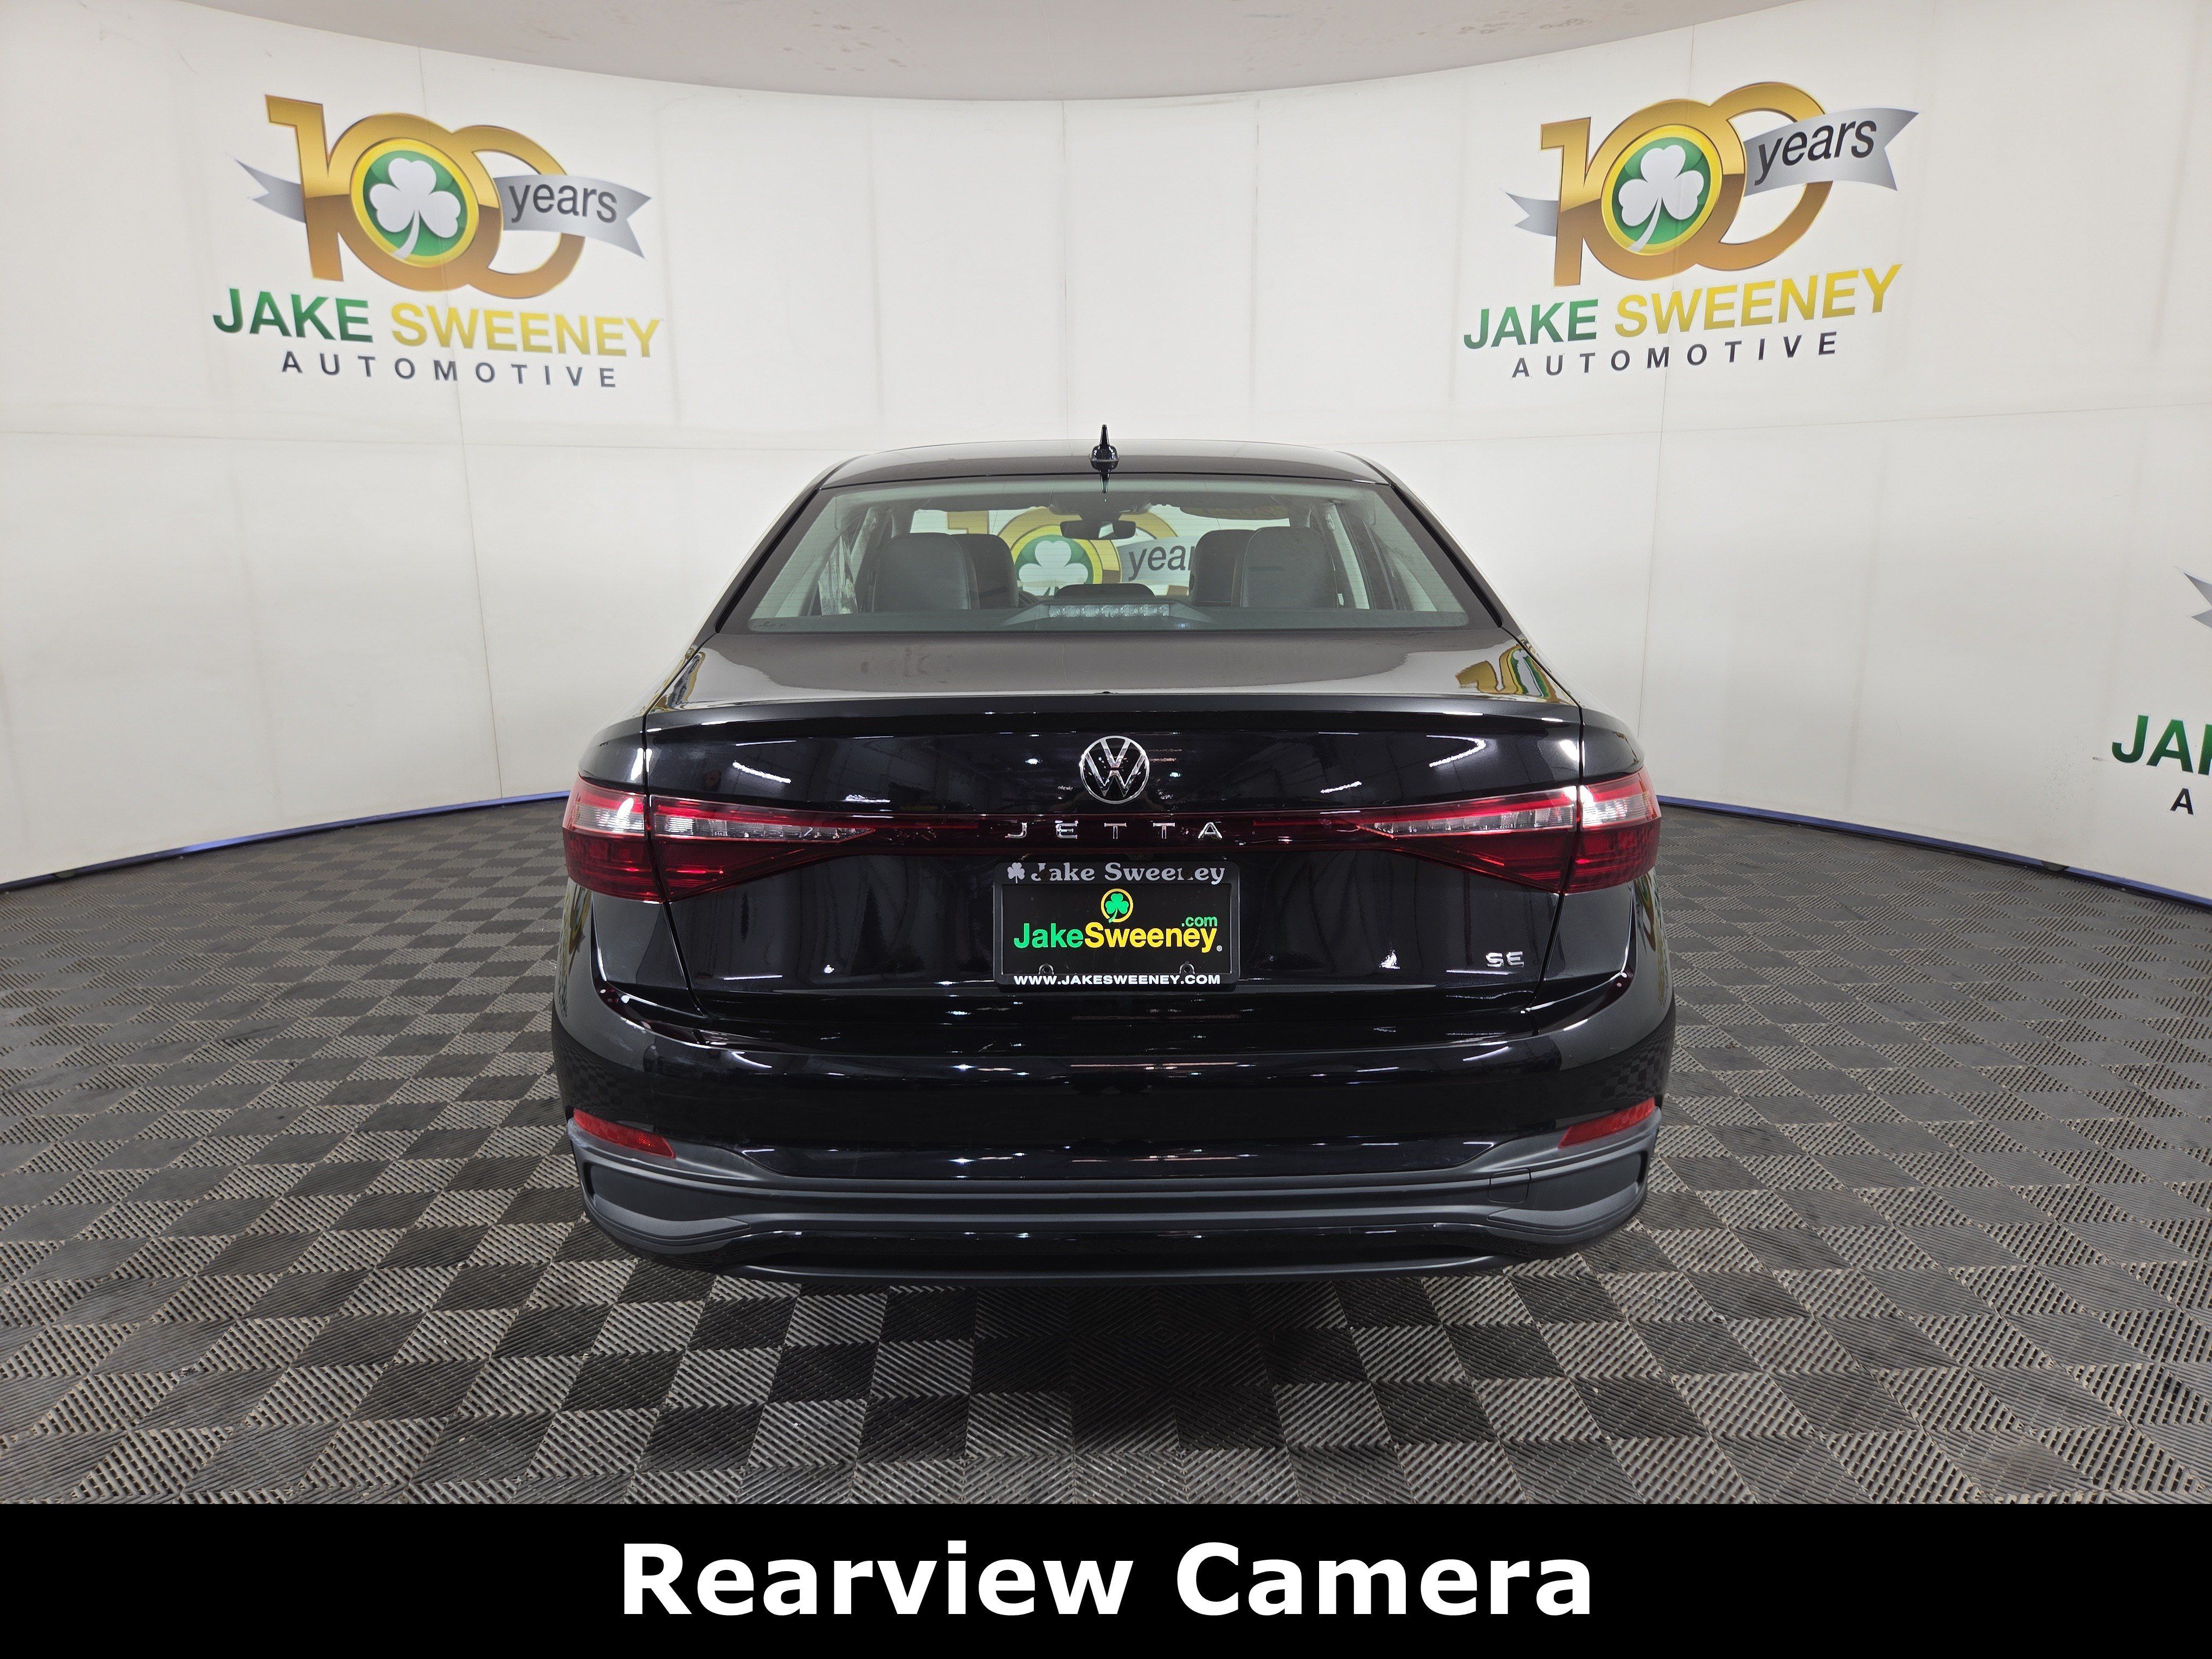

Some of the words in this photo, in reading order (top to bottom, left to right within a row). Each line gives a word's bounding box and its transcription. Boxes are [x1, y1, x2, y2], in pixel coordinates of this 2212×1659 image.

[1754, 118, 1877, 186] years
[509, 184, 618, 223] years
[213, 288, 373, 343] JAKE
[391, 302, 660, 357] SWEENEY
[1464, 299, 1598, 349] JAKE
[1614, 263, 1902, 338] SWEENEY
[281, 350, 616, 388] AUTOMOTIVE
[1512, 331, 1837, 378] AUTOMOTIVE
[1005, 820, 1223, 839] JETTA
[1486, 951, 1524, 968] SE
[1013, 975, 1220, 985] WWW.JAKESWEENEY.COM
